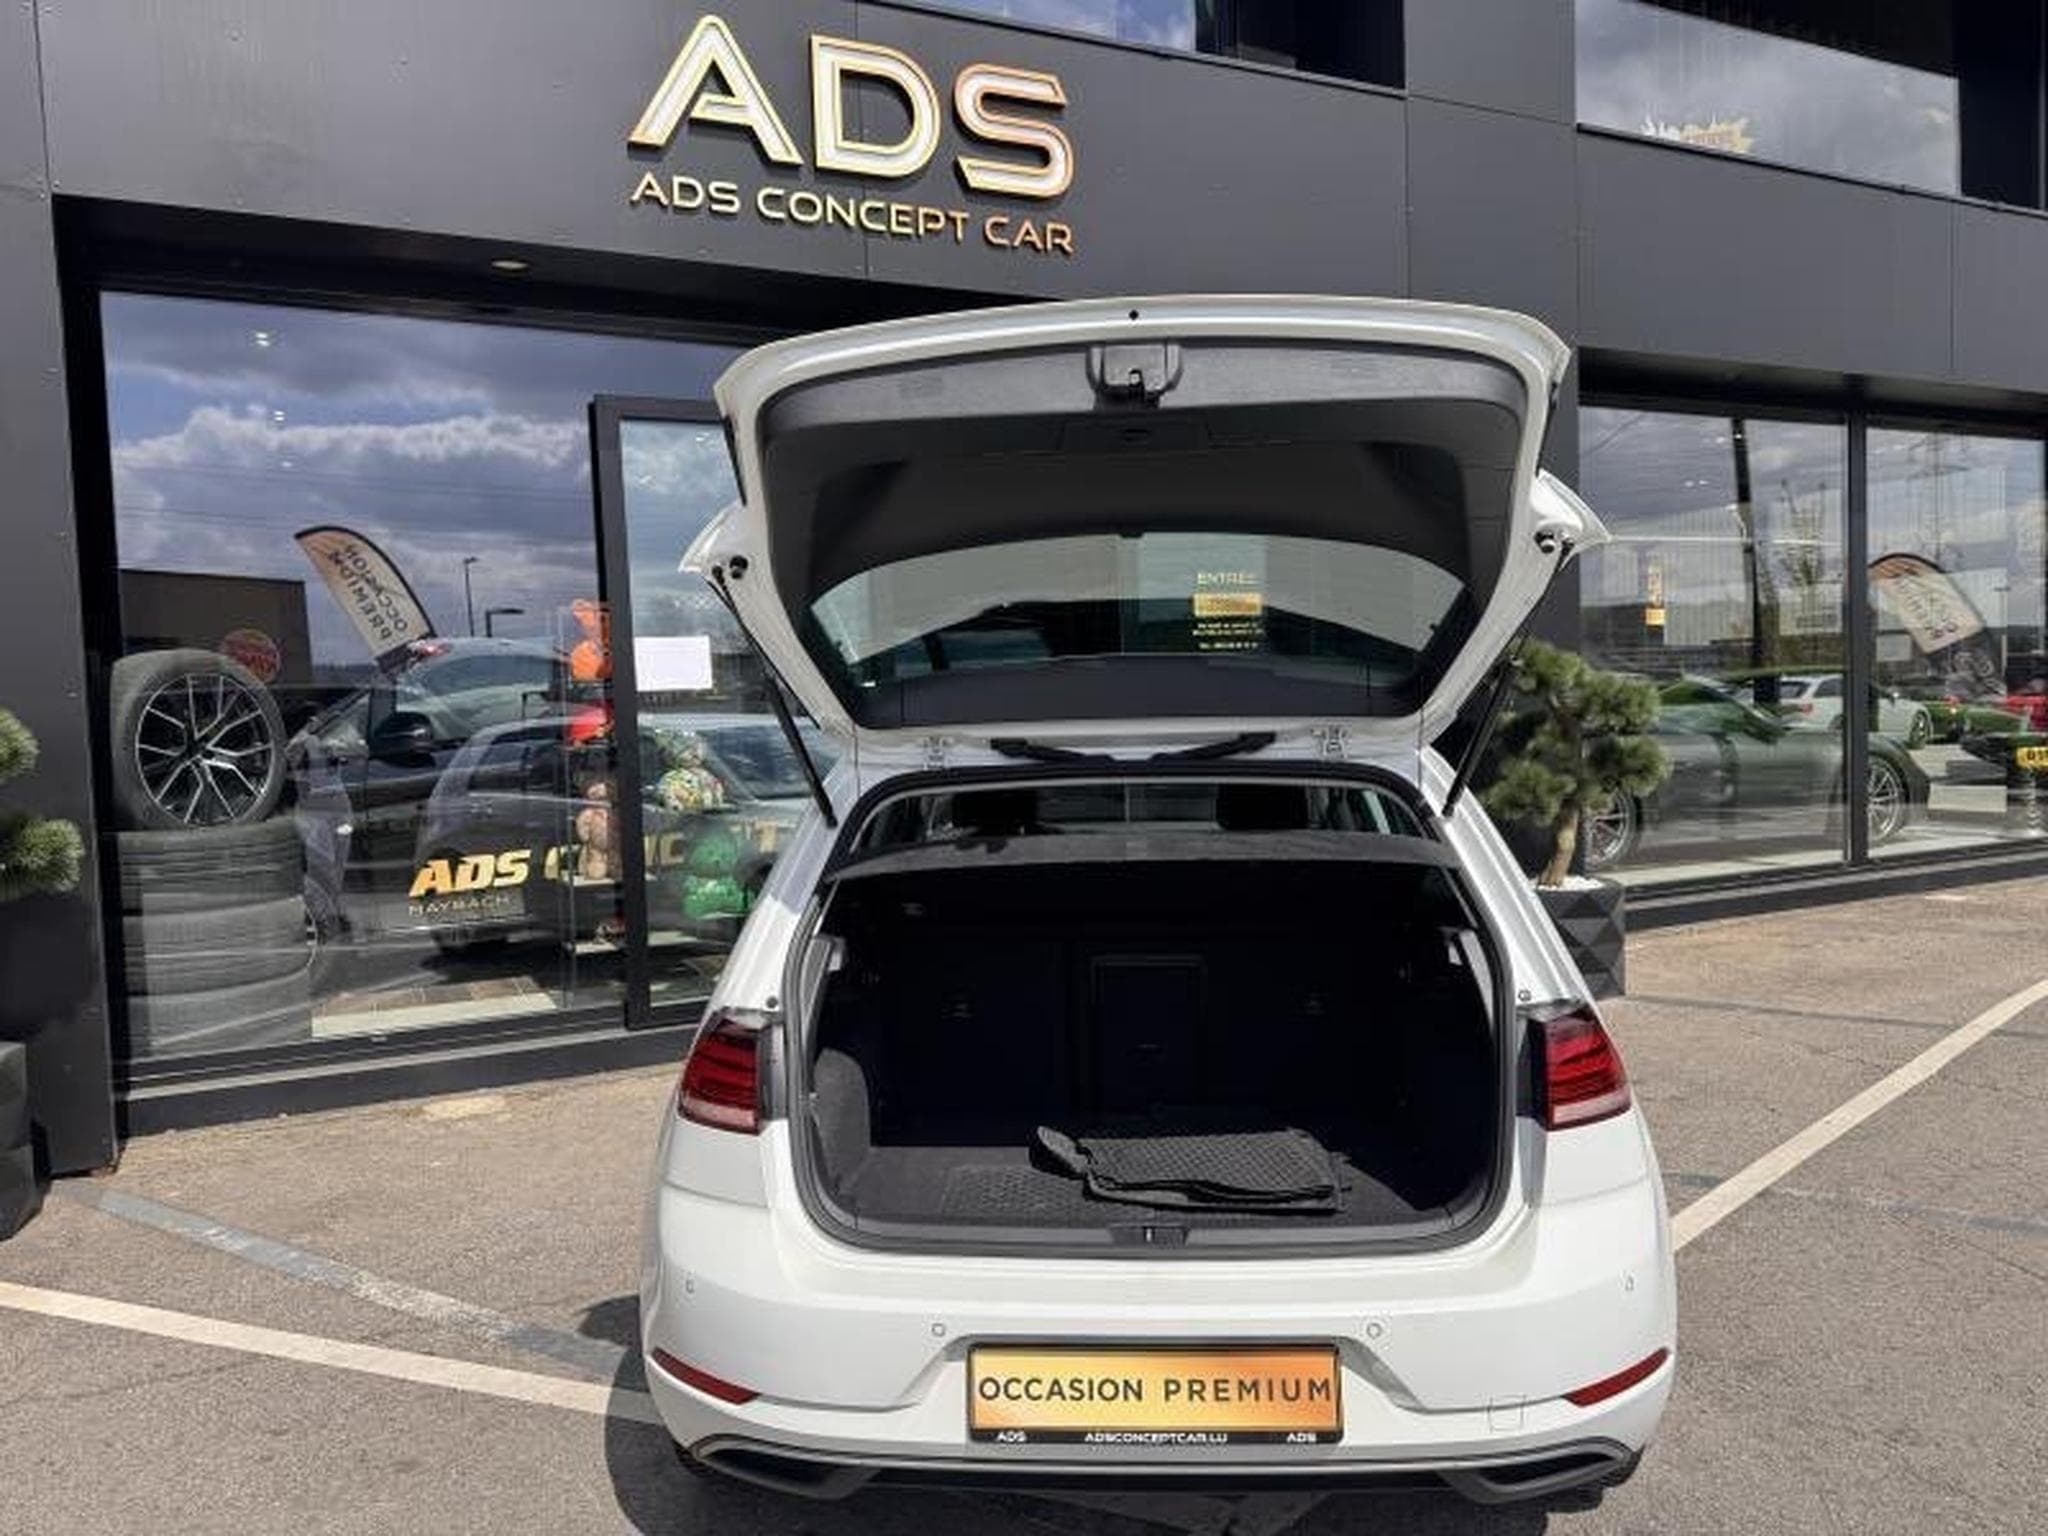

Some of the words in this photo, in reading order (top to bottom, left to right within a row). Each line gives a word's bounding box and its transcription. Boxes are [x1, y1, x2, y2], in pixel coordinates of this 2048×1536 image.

[627, 14, 1076, 199] ADS
[630, 171, 740, 213] ADS
[757, 187, 970, 243] CONCEPT
[984, 216, 1076, 254] CAR
[408, 849, 532, 898] ADS
[978, 1377, 1144, 1402] OCCASION
[1163, 1378, 1332, 1403] PREMIUM
[996, 1431, 1026, 1443] ADS
